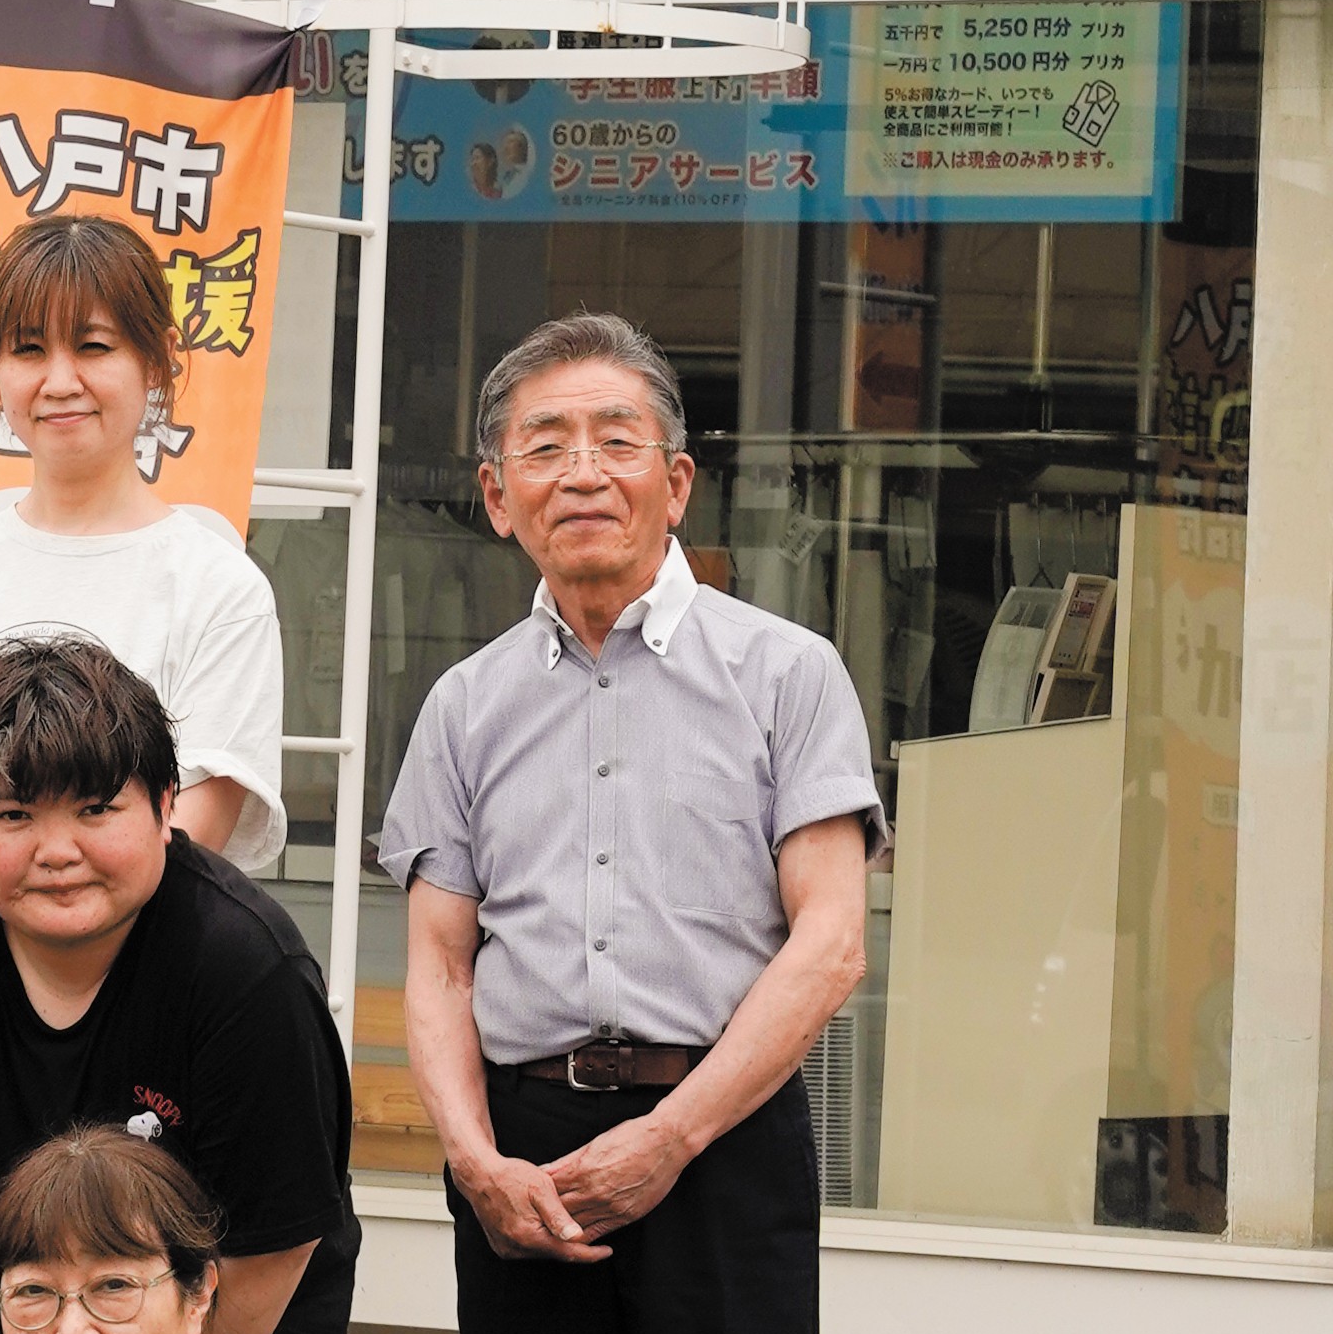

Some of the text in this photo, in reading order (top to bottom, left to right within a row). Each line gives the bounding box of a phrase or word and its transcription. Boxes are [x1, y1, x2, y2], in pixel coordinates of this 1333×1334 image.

[885, 24, 944, 41] 五千円で
[963, 18, 1028, 41] 5,250
[1033, 17, 1072, 39] 円分
[884, 56, 942, 73] 一万円で
[949, 51, 1027, 75] 10,500
[1033, 51, 1071, 72] 円分
[552, 123, 677, 146] 60歳からの
[551, 153, 817, 188] シニアサービス
